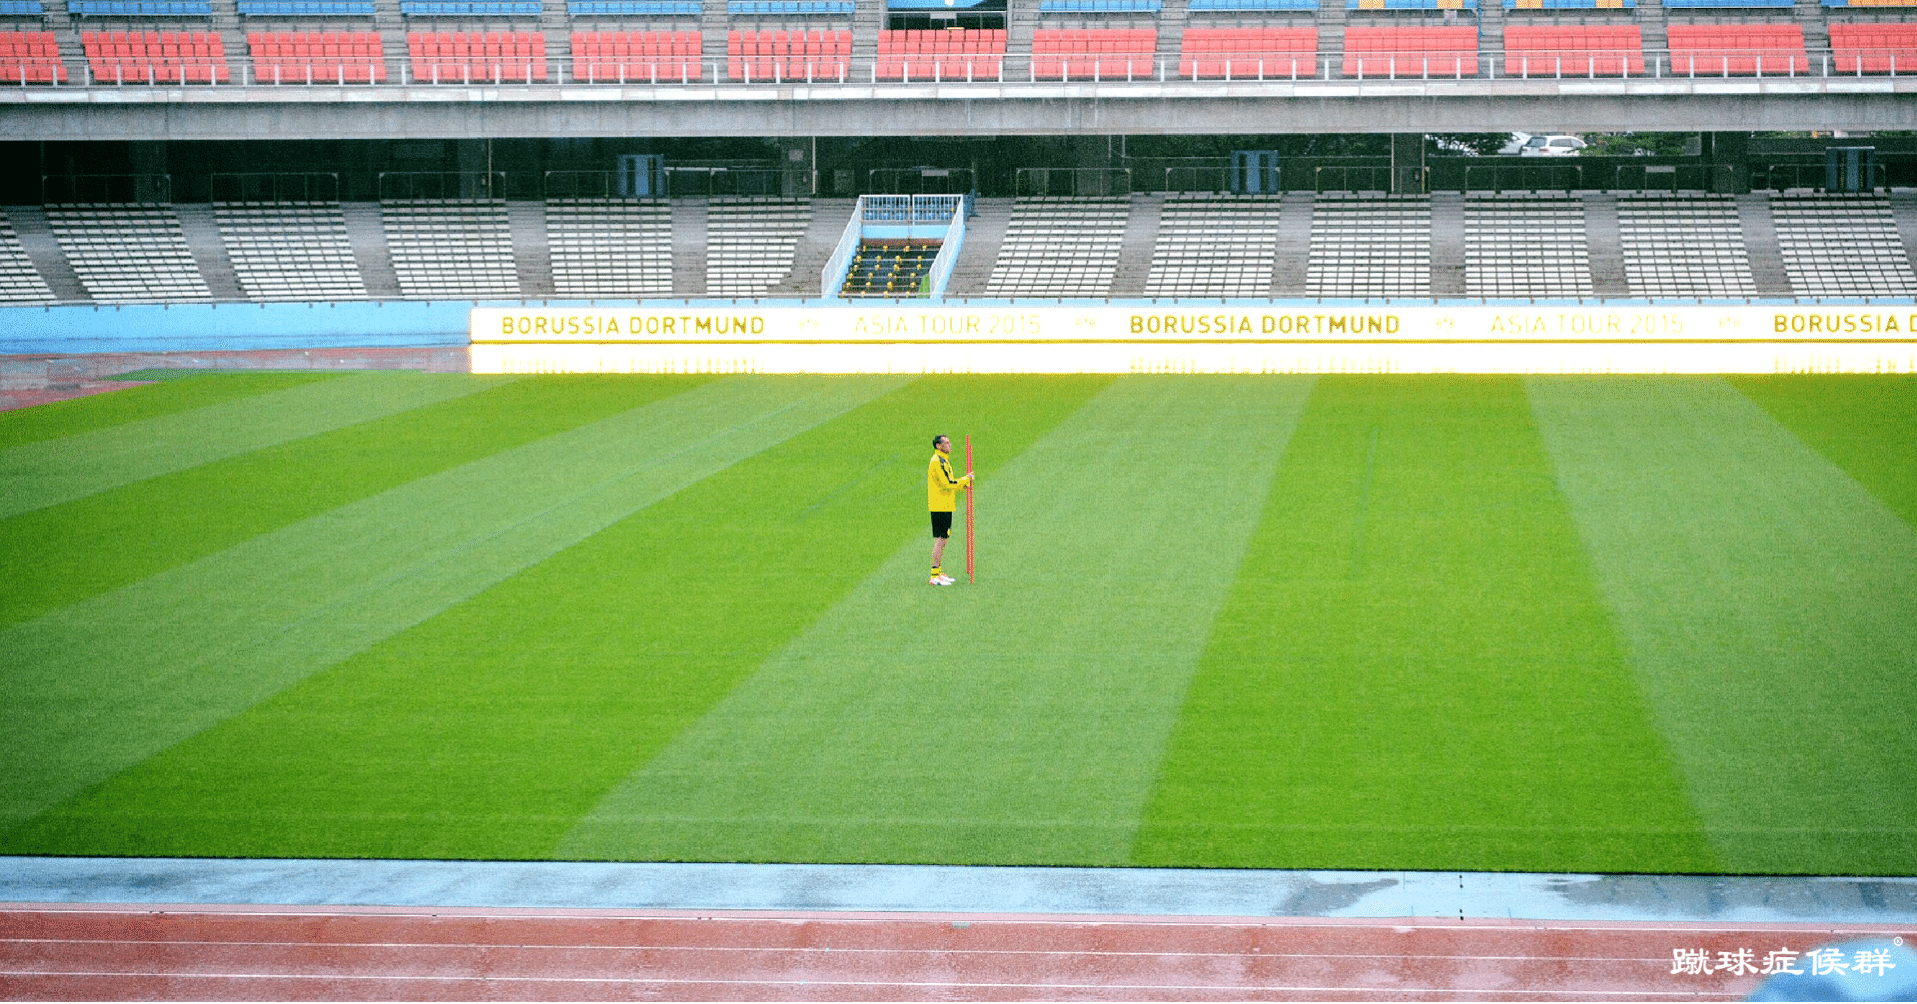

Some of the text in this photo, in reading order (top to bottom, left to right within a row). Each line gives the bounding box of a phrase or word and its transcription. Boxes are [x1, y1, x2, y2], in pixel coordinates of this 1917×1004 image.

[503, 316, 765, 335] BORUSSIA DORTMUND
[854, 314, 1041, 334] ASIA TOUR 2015
[1130, 314, 1400, 334] BORUSSIA DORTMUND
[1491, 314, 1684, 334] ASIA TOUR 2015
[1774, 313, 1899, 334] BORUSSIA
